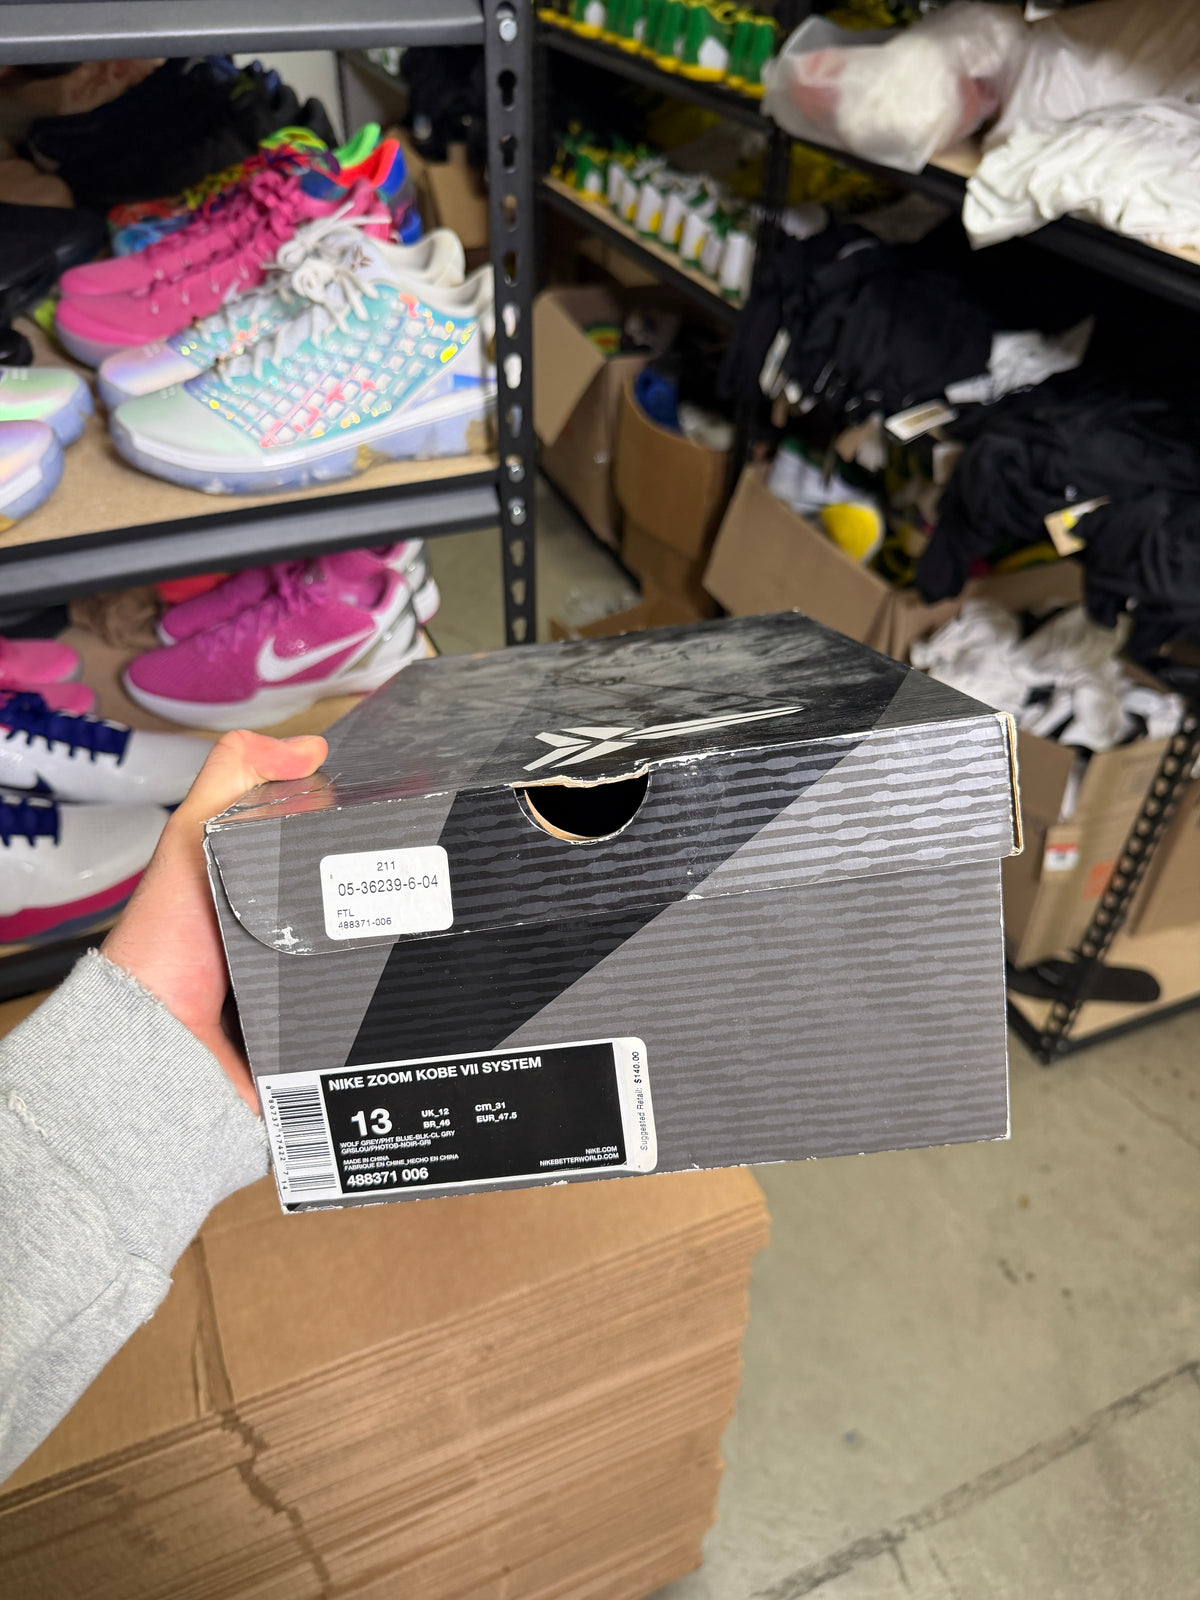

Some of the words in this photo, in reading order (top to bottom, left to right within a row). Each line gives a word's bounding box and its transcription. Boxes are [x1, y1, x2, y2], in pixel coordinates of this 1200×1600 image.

[376, 860, 397, 872] 211
[338, 874, 438, 896] 05-36239-6-04
[337, 908, 355, 918] FTL
[338, 917, 392, 929] 488371-006
[328, 1076, 364, 1092] NIKE
[367, 1070, 412, 1087] ZOOM
[416, 1066, 458, 1082] KOBE
[460, 1063, 479, 1076] VII
[482, 1056, 542, 1074] SYSTEM
[632, 1051, 642, 1084] $140.00
[475, 1101, 506, 1112] cm_31
[635, 1088, 645, 1110] Retail:
[421, 1108, 450, 1118] UK_12
[476, 1112, 518, 1124] EUR_47.5
[351, 1108, 392, 1136] 13
[423, 1118, 450, 1129] BR_46
[637, 1111, 648, 1151] Suggested
[340, 1140, 360, 1149] WOLF
[440, 1130, 456, 1138] GRY
[585, 1145, 618, 1156] NIKE.COM
[343, 1158, 362, 1166] MADE
[370, 1154, 390, 1162] CHINA
[344, 1162, 376, 1172] FABRIQUE
[376, 1160, 386, 1168] EN
[439, 1153, 460, 1161] CHINA
[540, 1152, 620, 1167] NIKEBETTERWORLD.COM
[346, 1170, 398, 1188] 488371
[402, 1166, 430, 1182] 006
